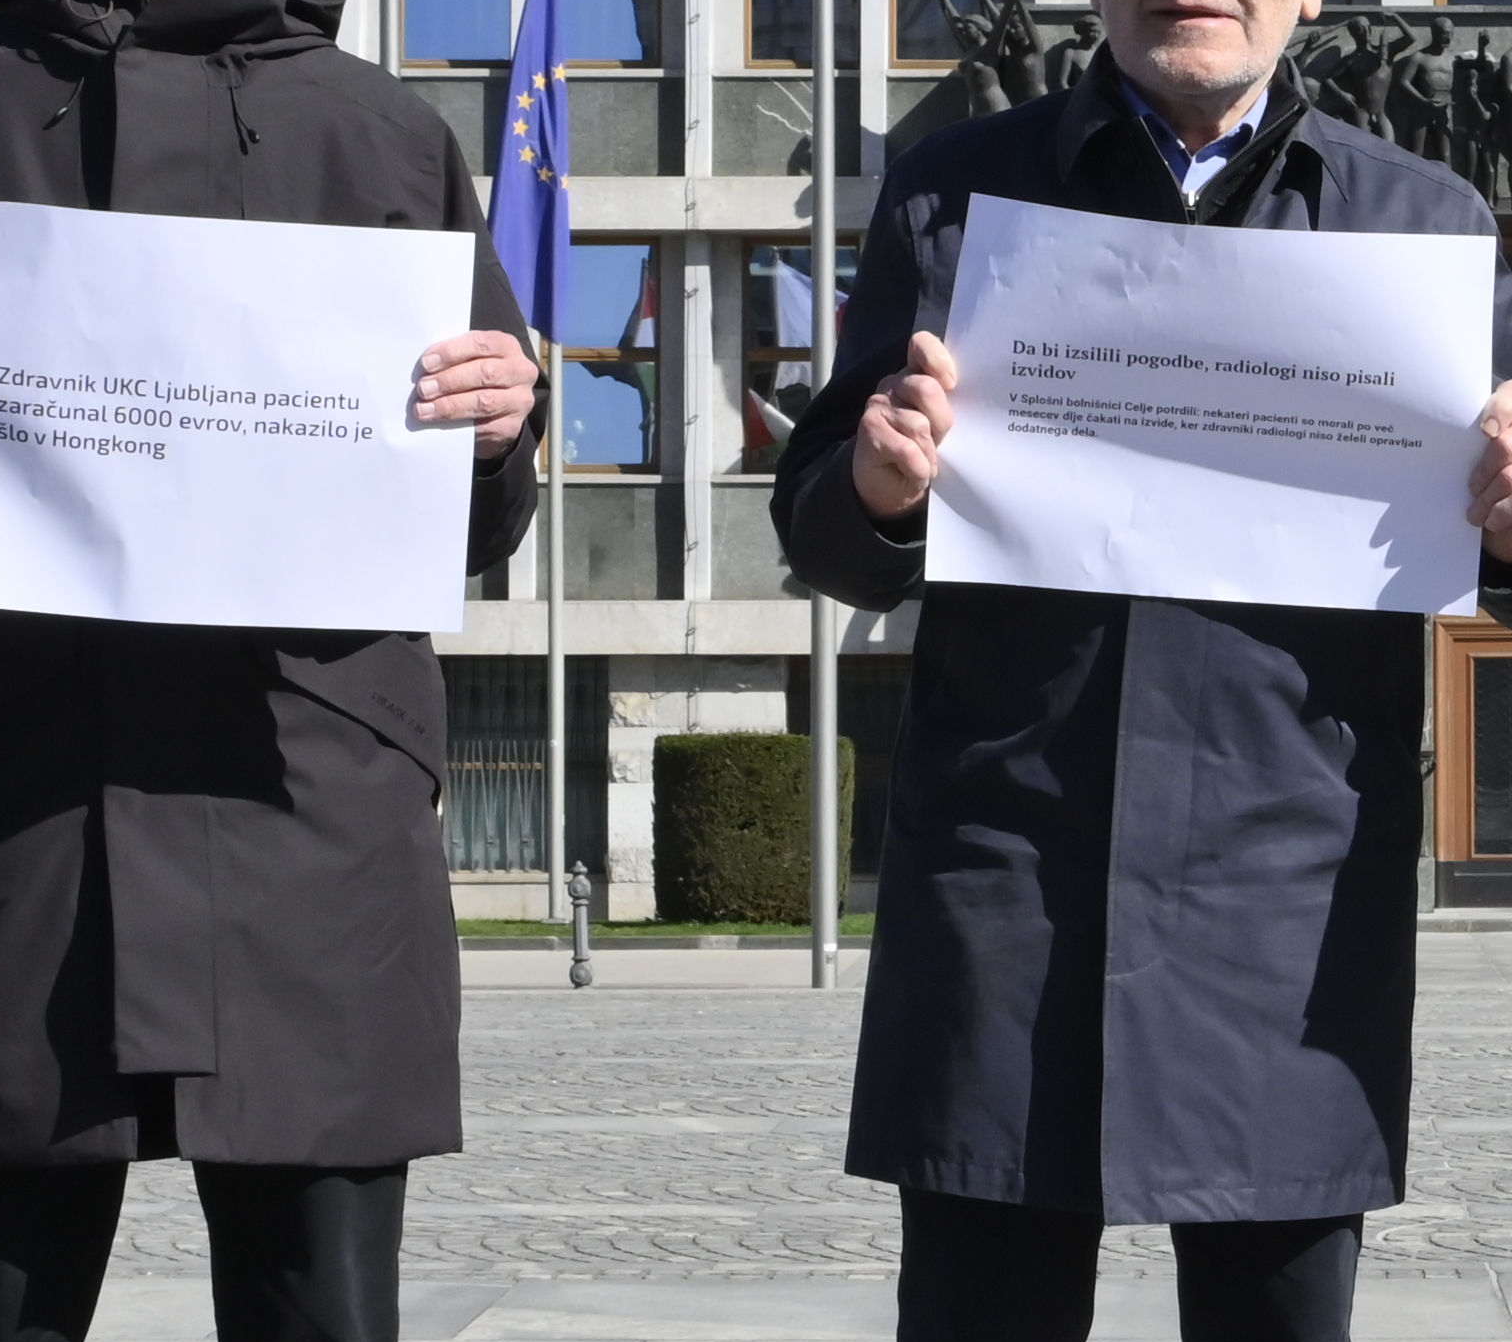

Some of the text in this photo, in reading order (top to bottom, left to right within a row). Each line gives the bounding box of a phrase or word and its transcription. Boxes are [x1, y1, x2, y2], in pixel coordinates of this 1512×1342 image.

[1011, 361, 1076, 380] izvidov
[1012, 339, 1395, 387] Da bi izsilili pogodbe, radiologi niso pisali
[103, 376, 148, 398] UKC
[154, 380, 257, 407] Ljubljana
[263, 390, 360, 411] pacientu
[114, 405, 173, 428] 6000
[179, 416, 247, 436] evrov,
[254, 417, 348, 439] nakazilo
[353, 421, 373, 444] je
[1007, 421, 1069, 438] dodatnega
[1008, 408, 1060, 420] mesecev
[1062, 411, 1084, 424] dlje
[1086, 412, 1121, 425] čakati
[1123, 417, 1138, 426] na
[1180, 419, 1200, 431] ker
[1201, 421, 1254, 435] zdravniki
[1255, 426, 1307, 441] radiologi
[1308, 430, 1334, 441] niso
[1336, 432, 1367, 444] želeli
[1369, 437, 1423, 449] opravljati
[1009, 392, 1018, 403] V
[1020, 393, 1064, 407] Splošni
[1065, 396, 1122, 411] bolnišnici
[1124, 401, 1154, 415] Celje
[1202, 408, 1250, 421] nekateri
[1252, 413, 1299, 425] pacienti
[1301, 418, 1316, 426] so
[1317, 419, 1354, 430] morali
[1356, 422, 1372, 433] po
[1374, 424, 1394, 433] več
[33, 432, 47, 446] v
[52, 429, 166, 461] Hongkong
